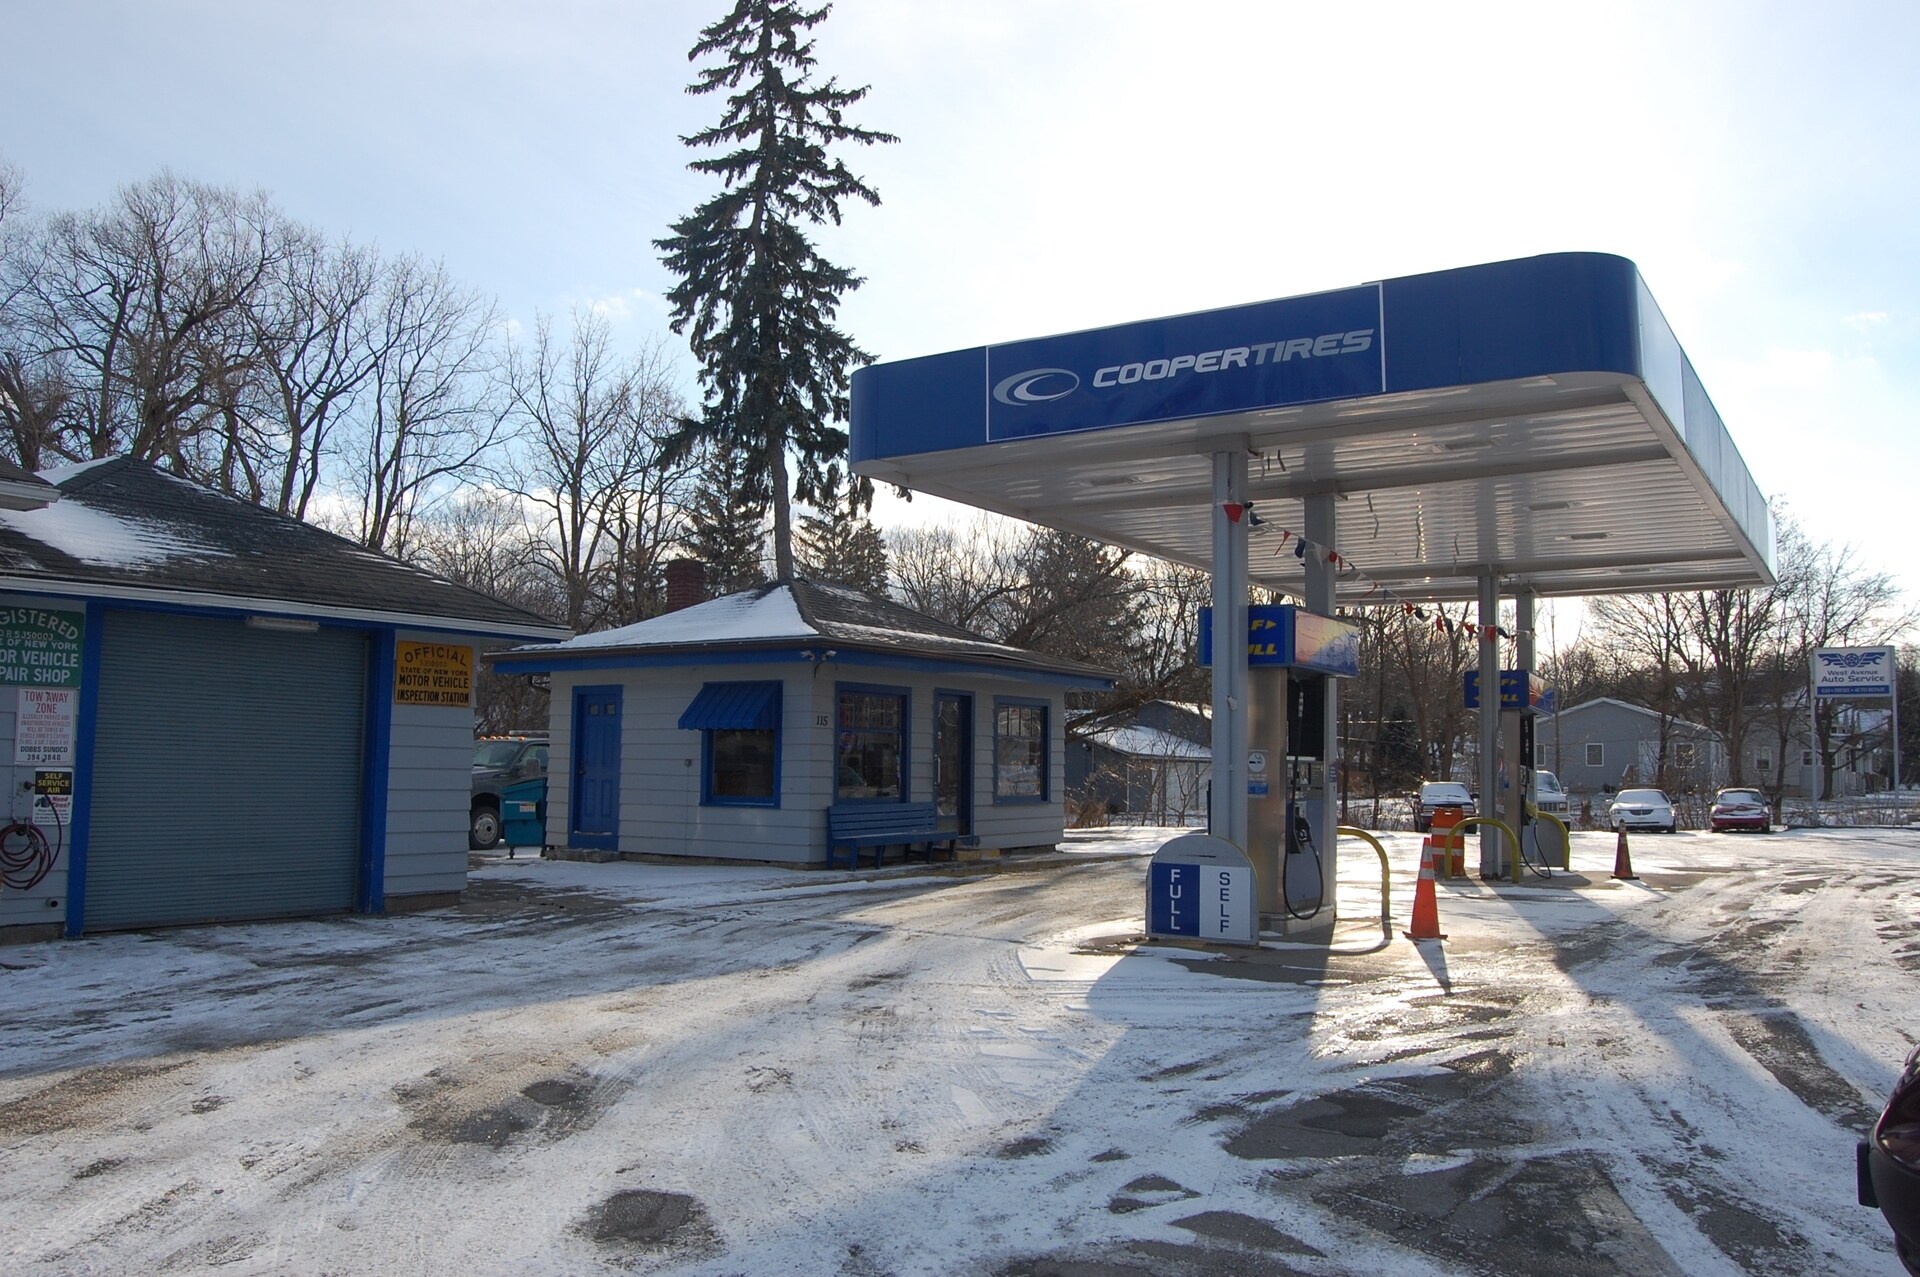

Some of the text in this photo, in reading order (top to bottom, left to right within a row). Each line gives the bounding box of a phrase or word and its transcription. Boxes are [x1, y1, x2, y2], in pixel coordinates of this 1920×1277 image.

[7, 639, 21, 647] OF
[25, 640, 47, 648] NEW
[51, 642, 78, 650] YORK
[22, 650, 79, 667] VEHICLE
[404, 646, 466, 666] OFFICIAL
[33, 668, 70, 683] SHOP
[399, 674, 469, 689] MOTOR VEHICLE
[1821, 675, 1885, 683] Auto Service
[25, 691, 68, 703] TOW AWAY
[397, 689, 469, 704] INSPECTION STATION
[36, 703, 57, 713] ZONE
[816, 715, 828, 726] 115
[1169, 869, 1182, 930] FULL
[1219, 872, 1231, 933] SELF
